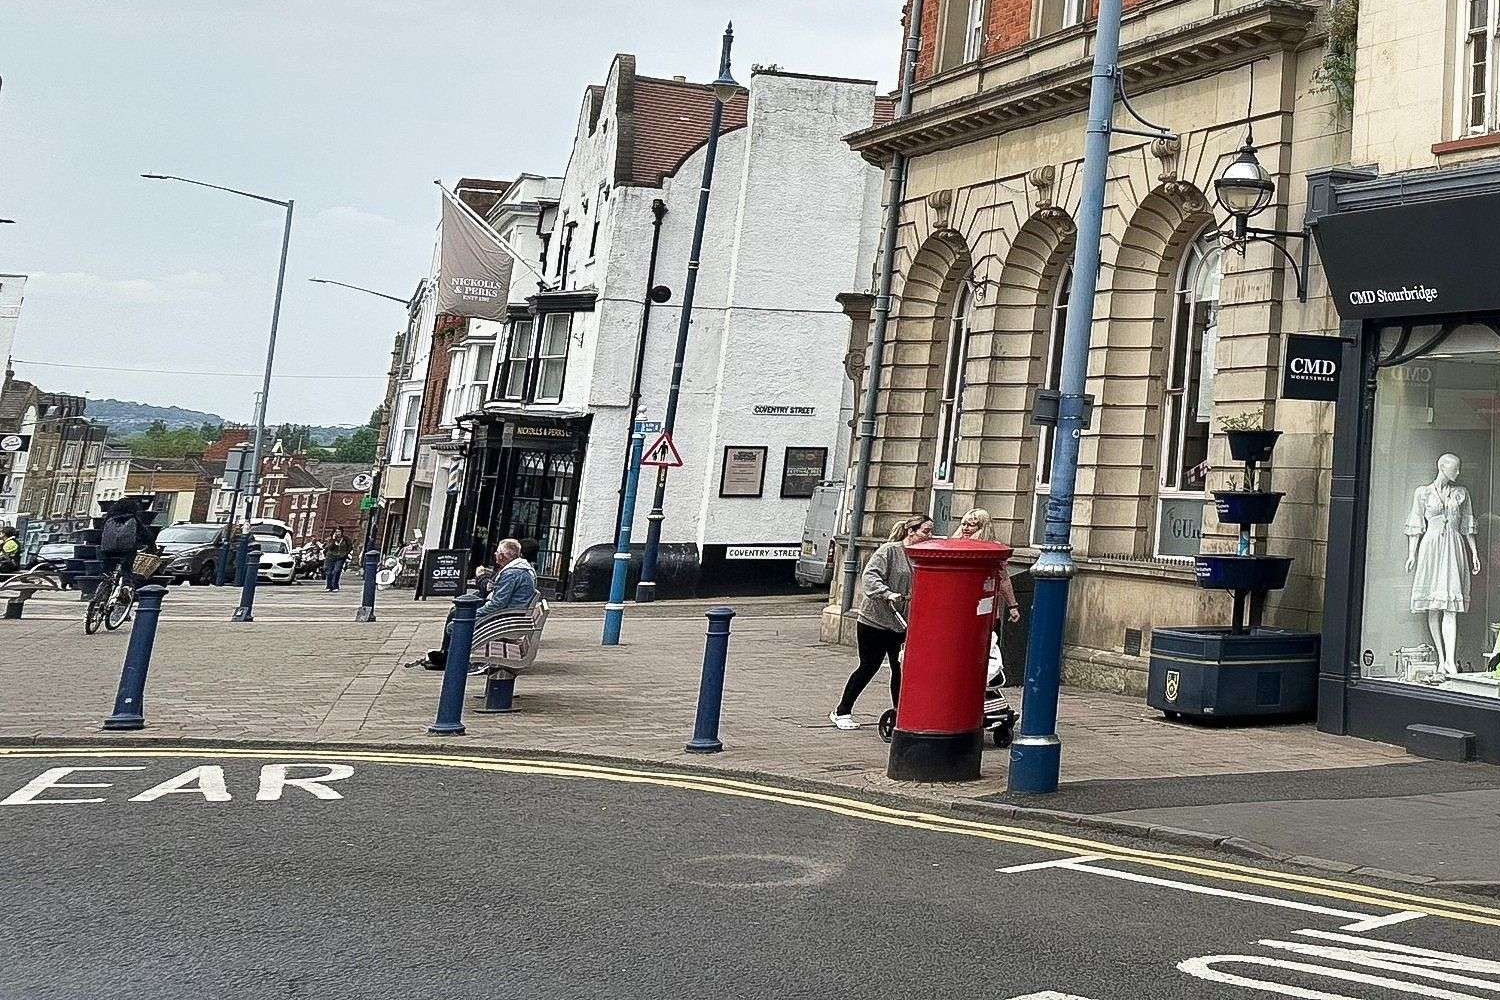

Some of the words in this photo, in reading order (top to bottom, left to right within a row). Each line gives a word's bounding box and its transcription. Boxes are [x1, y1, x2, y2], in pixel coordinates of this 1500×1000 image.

[451, 277, 502, 290] NICKOLLS
[464, 286, 499, 298] PERKS
[1349, 290, 1376, 305] CMD
[1377, 284, 1438, 304] Stourbridge
[1290, 357, 1336, 376] CMD
[754, 405, 788, 414] COVENTRY
[789, 406, 816, 415] STREET
[729, 549, 769, 557] COVENTRY
[773, 549, 801, 557] STREET
[433, 569, 461, 577] OPEN
